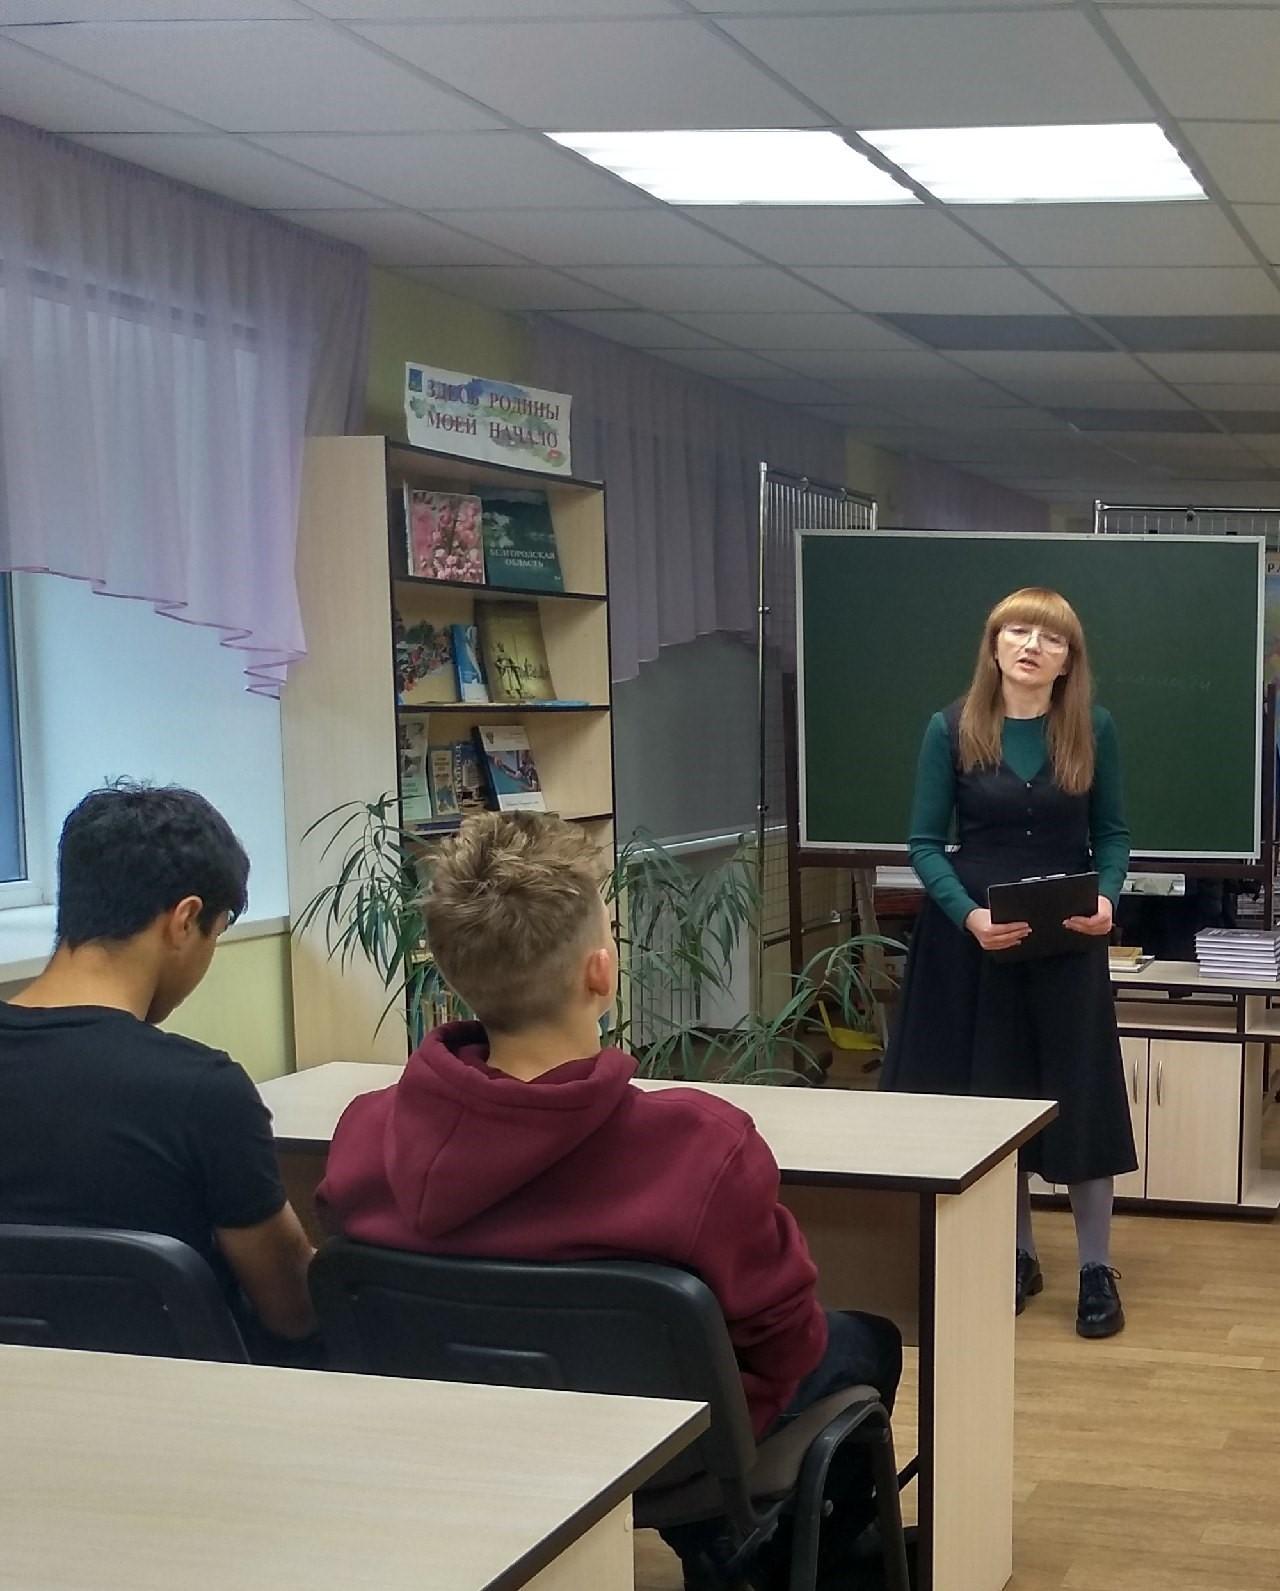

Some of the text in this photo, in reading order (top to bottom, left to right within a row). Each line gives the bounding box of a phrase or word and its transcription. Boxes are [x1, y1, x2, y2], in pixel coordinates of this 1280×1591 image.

[427, 378, 560, 421] ЗДЕСЬ РОДИНЫ
[426, 410, 559, 448] МОЕЙ НАЧАЛО
